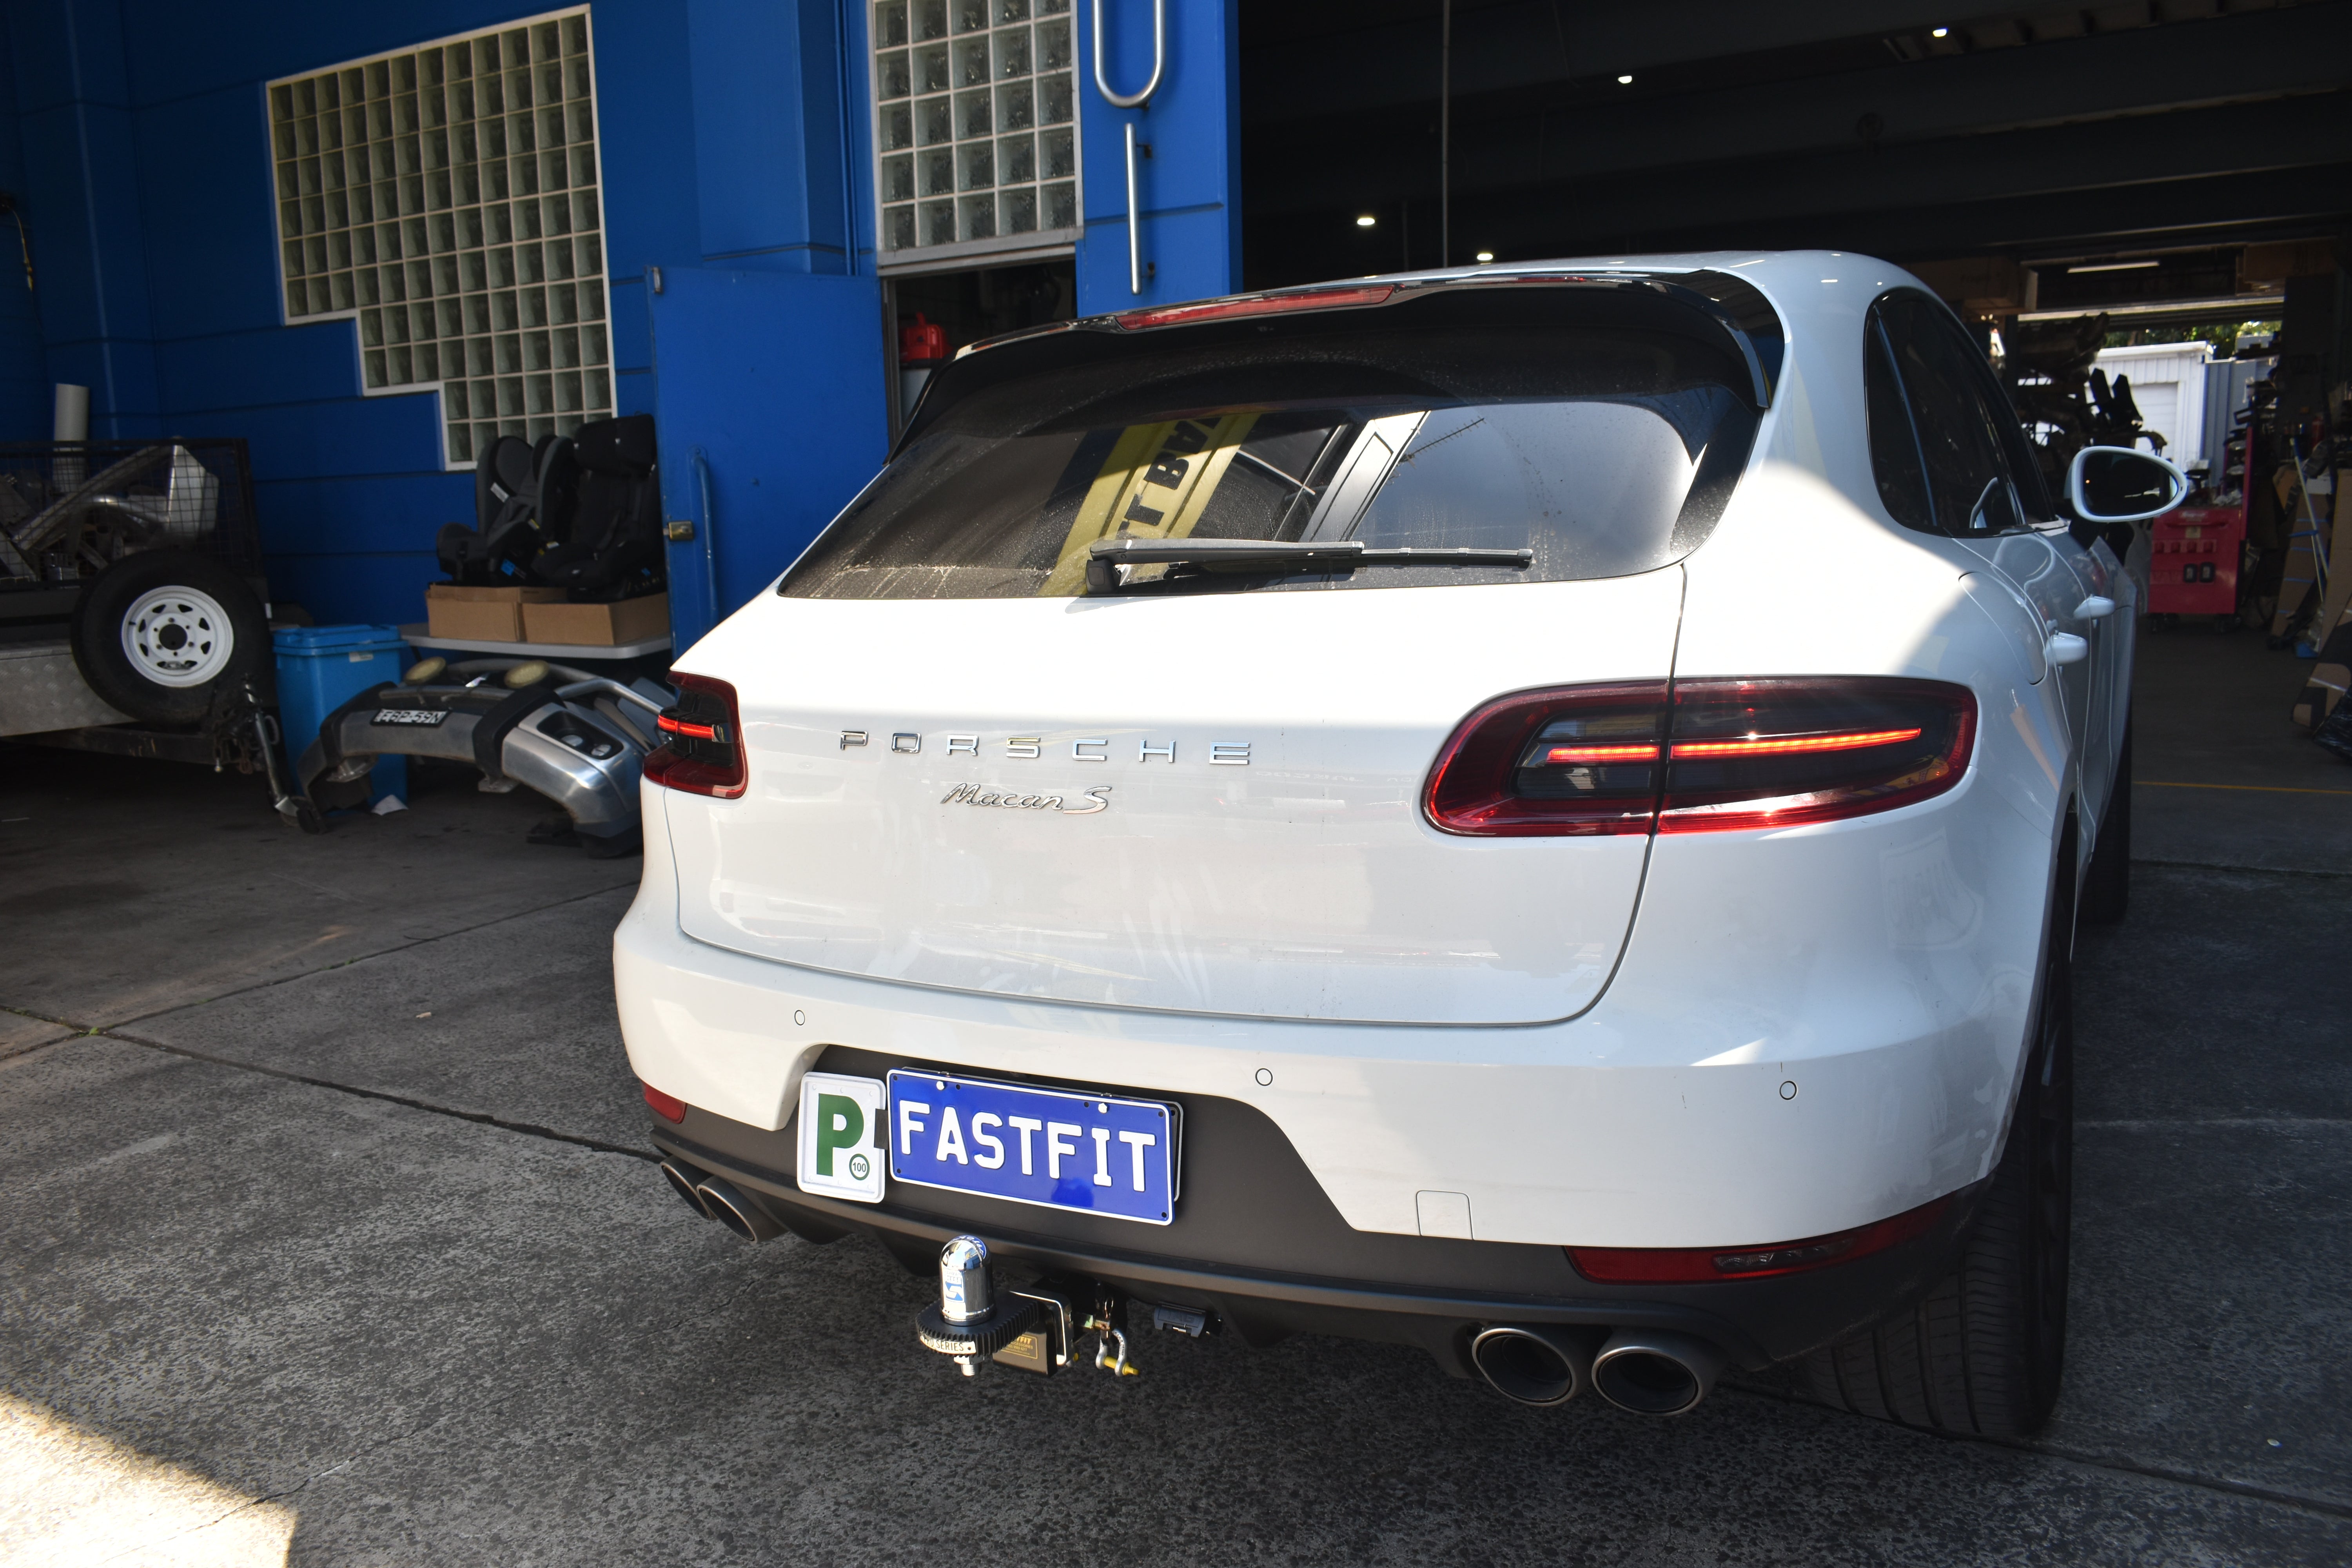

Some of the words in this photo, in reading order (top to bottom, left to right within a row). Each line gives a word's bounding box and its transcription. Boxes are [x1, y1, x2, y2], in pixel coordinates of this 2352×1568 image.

[840, 730, 1250, 765] PORSCHE
[940, 782, 1063, 810] Macan
[1063, 786, 1112, 814] S
[816, 1093, 864, 1177] P
[899, 1099, 1156, 1192] FASTFIT
[853, 1162, 866, 1172] 100
[936, 1340, 964, 1351] SERIES
